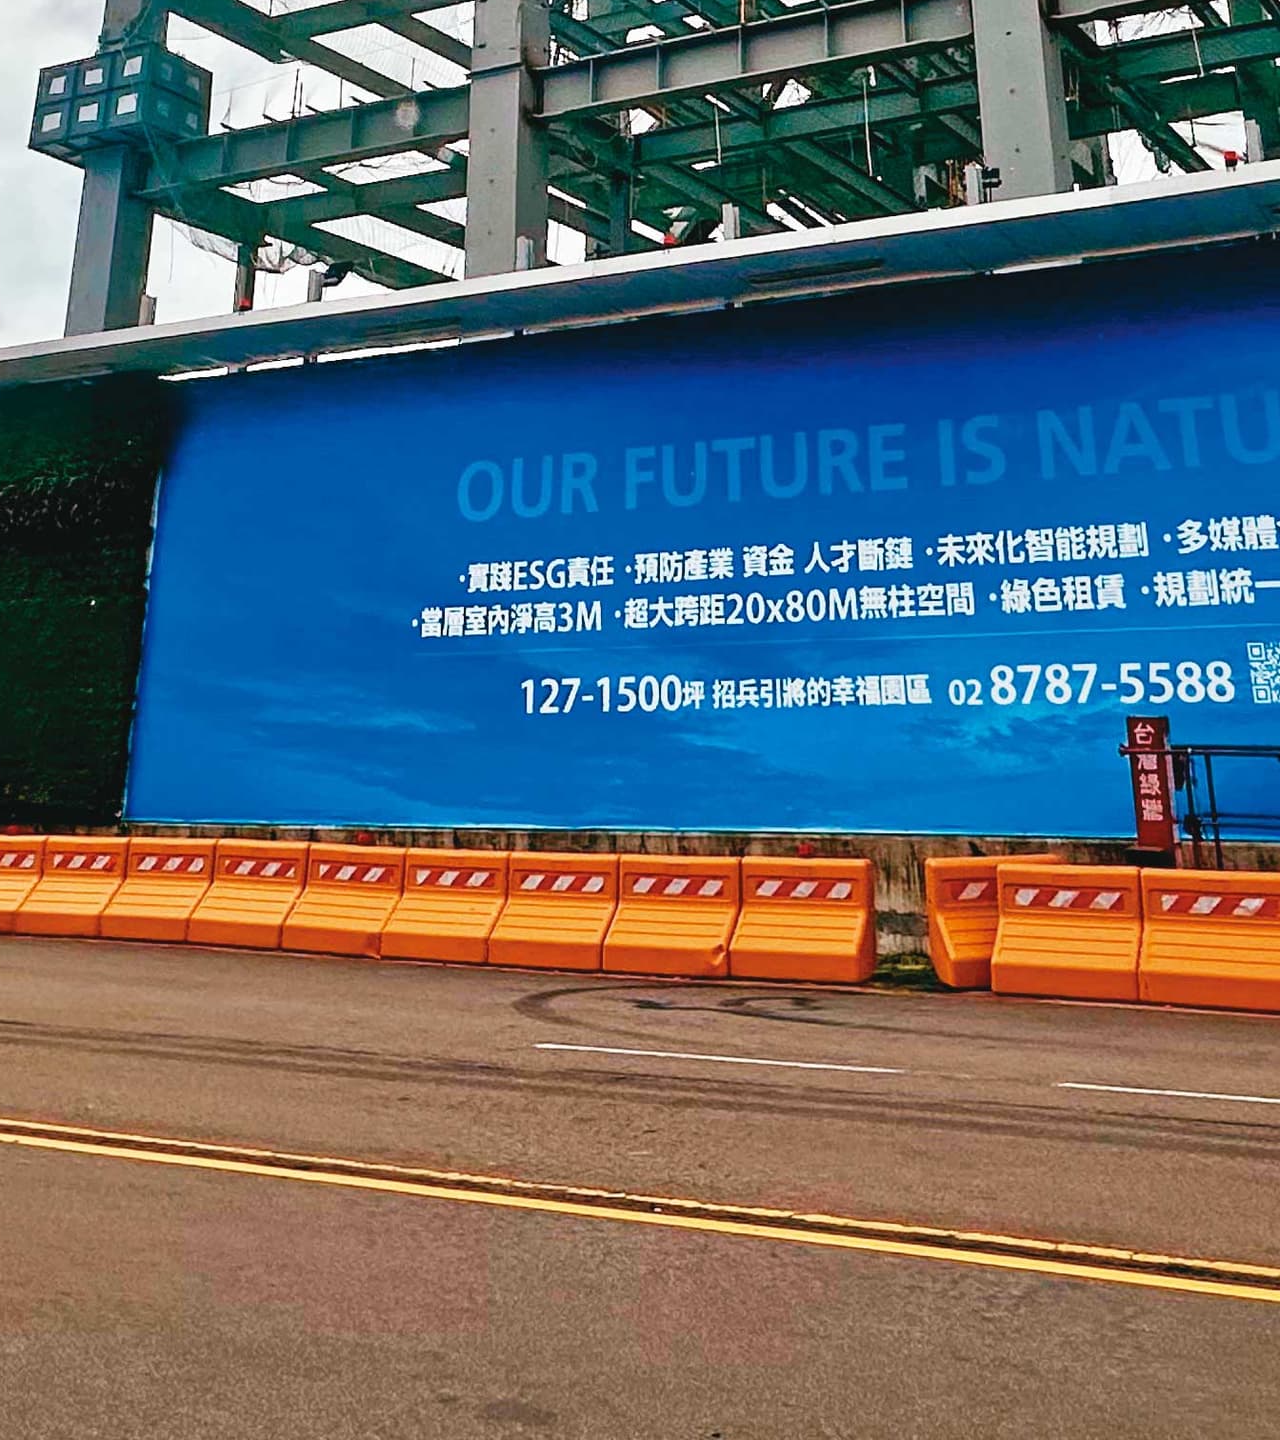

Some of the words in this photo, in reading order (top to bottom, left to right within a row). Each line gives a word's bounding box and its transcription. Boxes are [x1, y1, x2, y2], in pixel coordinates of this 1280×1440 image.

[457, 452, 599, 523] OUR
[623, 424, 909, 511] FUTURE
[937, 414, 1007, 487] IS
[742, 543, 795, 578] 資金
[711, 672, 933, 710] 招兵引將的幸福園區
[948, 678, 984, 706] 02
[989, 660, 1236, 706] 8787-5588
